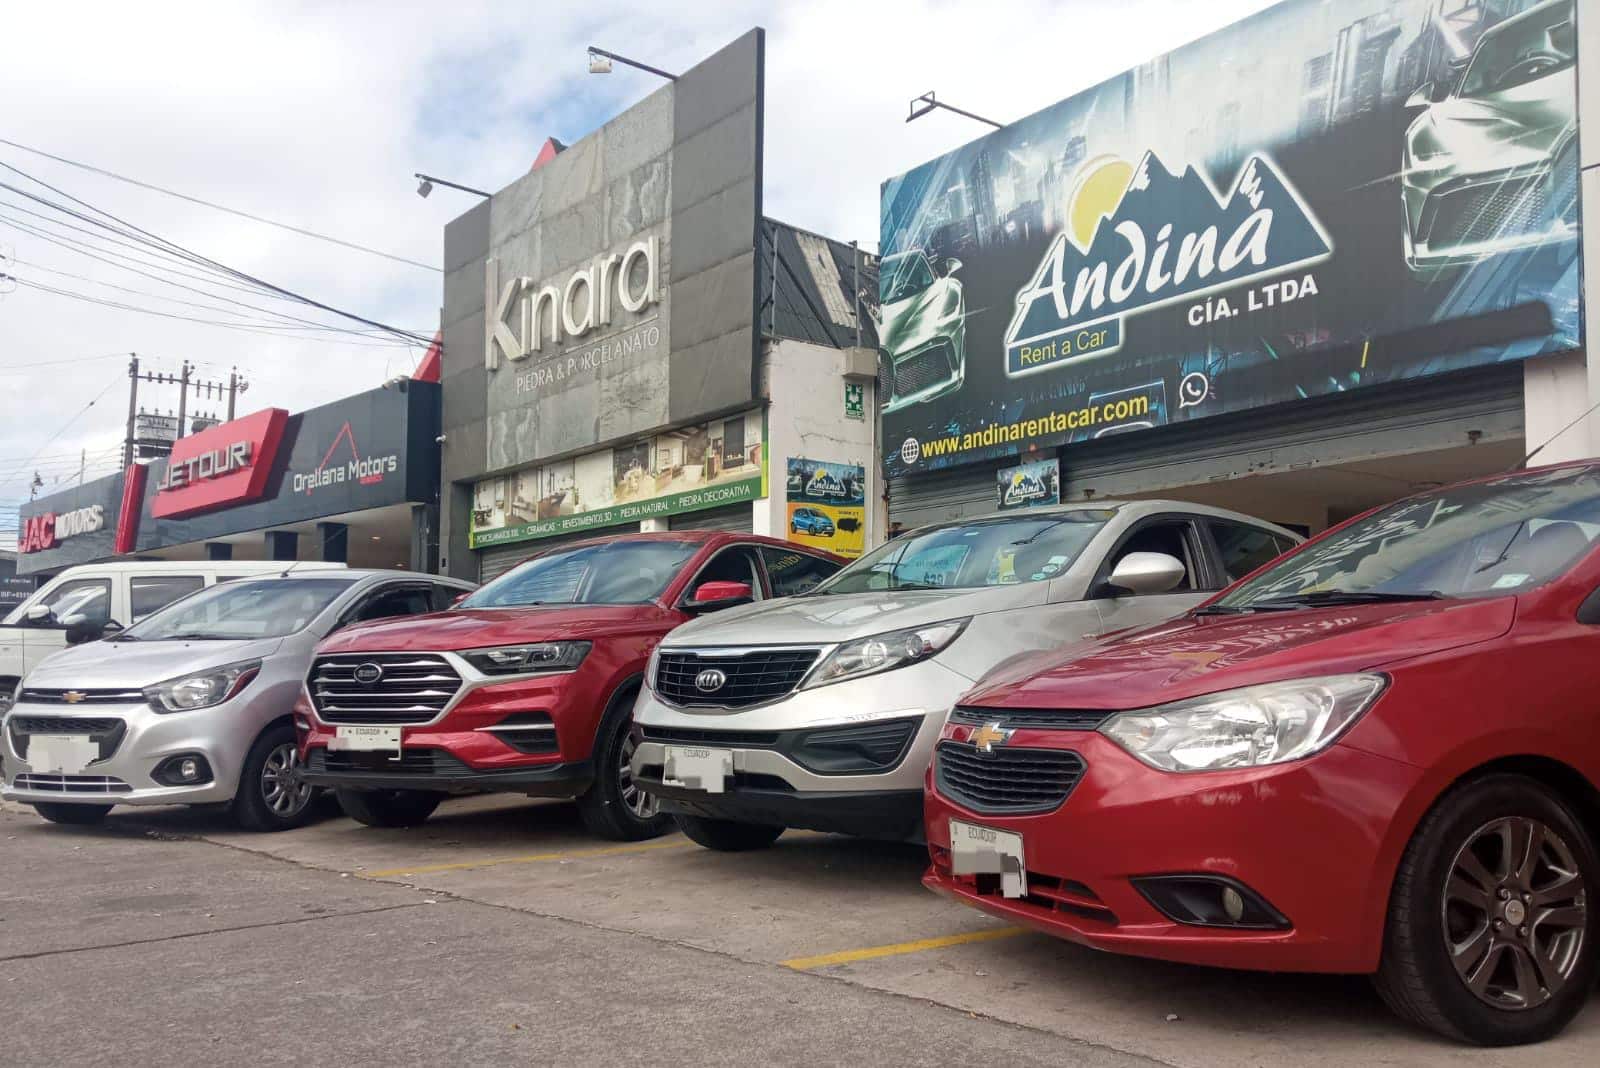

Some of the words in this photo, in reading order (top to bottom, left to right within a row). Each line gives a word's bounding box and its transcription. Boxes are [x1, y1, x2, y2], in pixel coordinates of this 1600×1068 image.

[1011, 208, 1273, 324] Andina
[485, 235, 660, 370] Kinara
[1188, 297, 1239, 326] CÍA.
[1247, 274, 1319, 312] LTDA
[1020, 337, 1057, 366] Rent
[1061, 340, 1071, 355] a
[1077, 327, 1107, 351] Car
[517, 366, 554, 395] PIEDRA
[556, 363, 565, 381] &
[921, 395, 1148, 458] www.andinarentacar.com
[157, 440, 250, 490] JETOUR
[293, 466, 344, 492] Orellana
[349, 455, 397, 481] Motors
[620, 507, 641, 518] PIEDRA
[641, 501, 669, 514] NATURAL
[679, 495, 702, 508] PIEDRA
[704, 485, 750, 502] DECORATIVA
[17, 512, 57, 553] JAC
[54, 505, 104, 540] MOTORS
[697, 674, 719, 687] KIA
